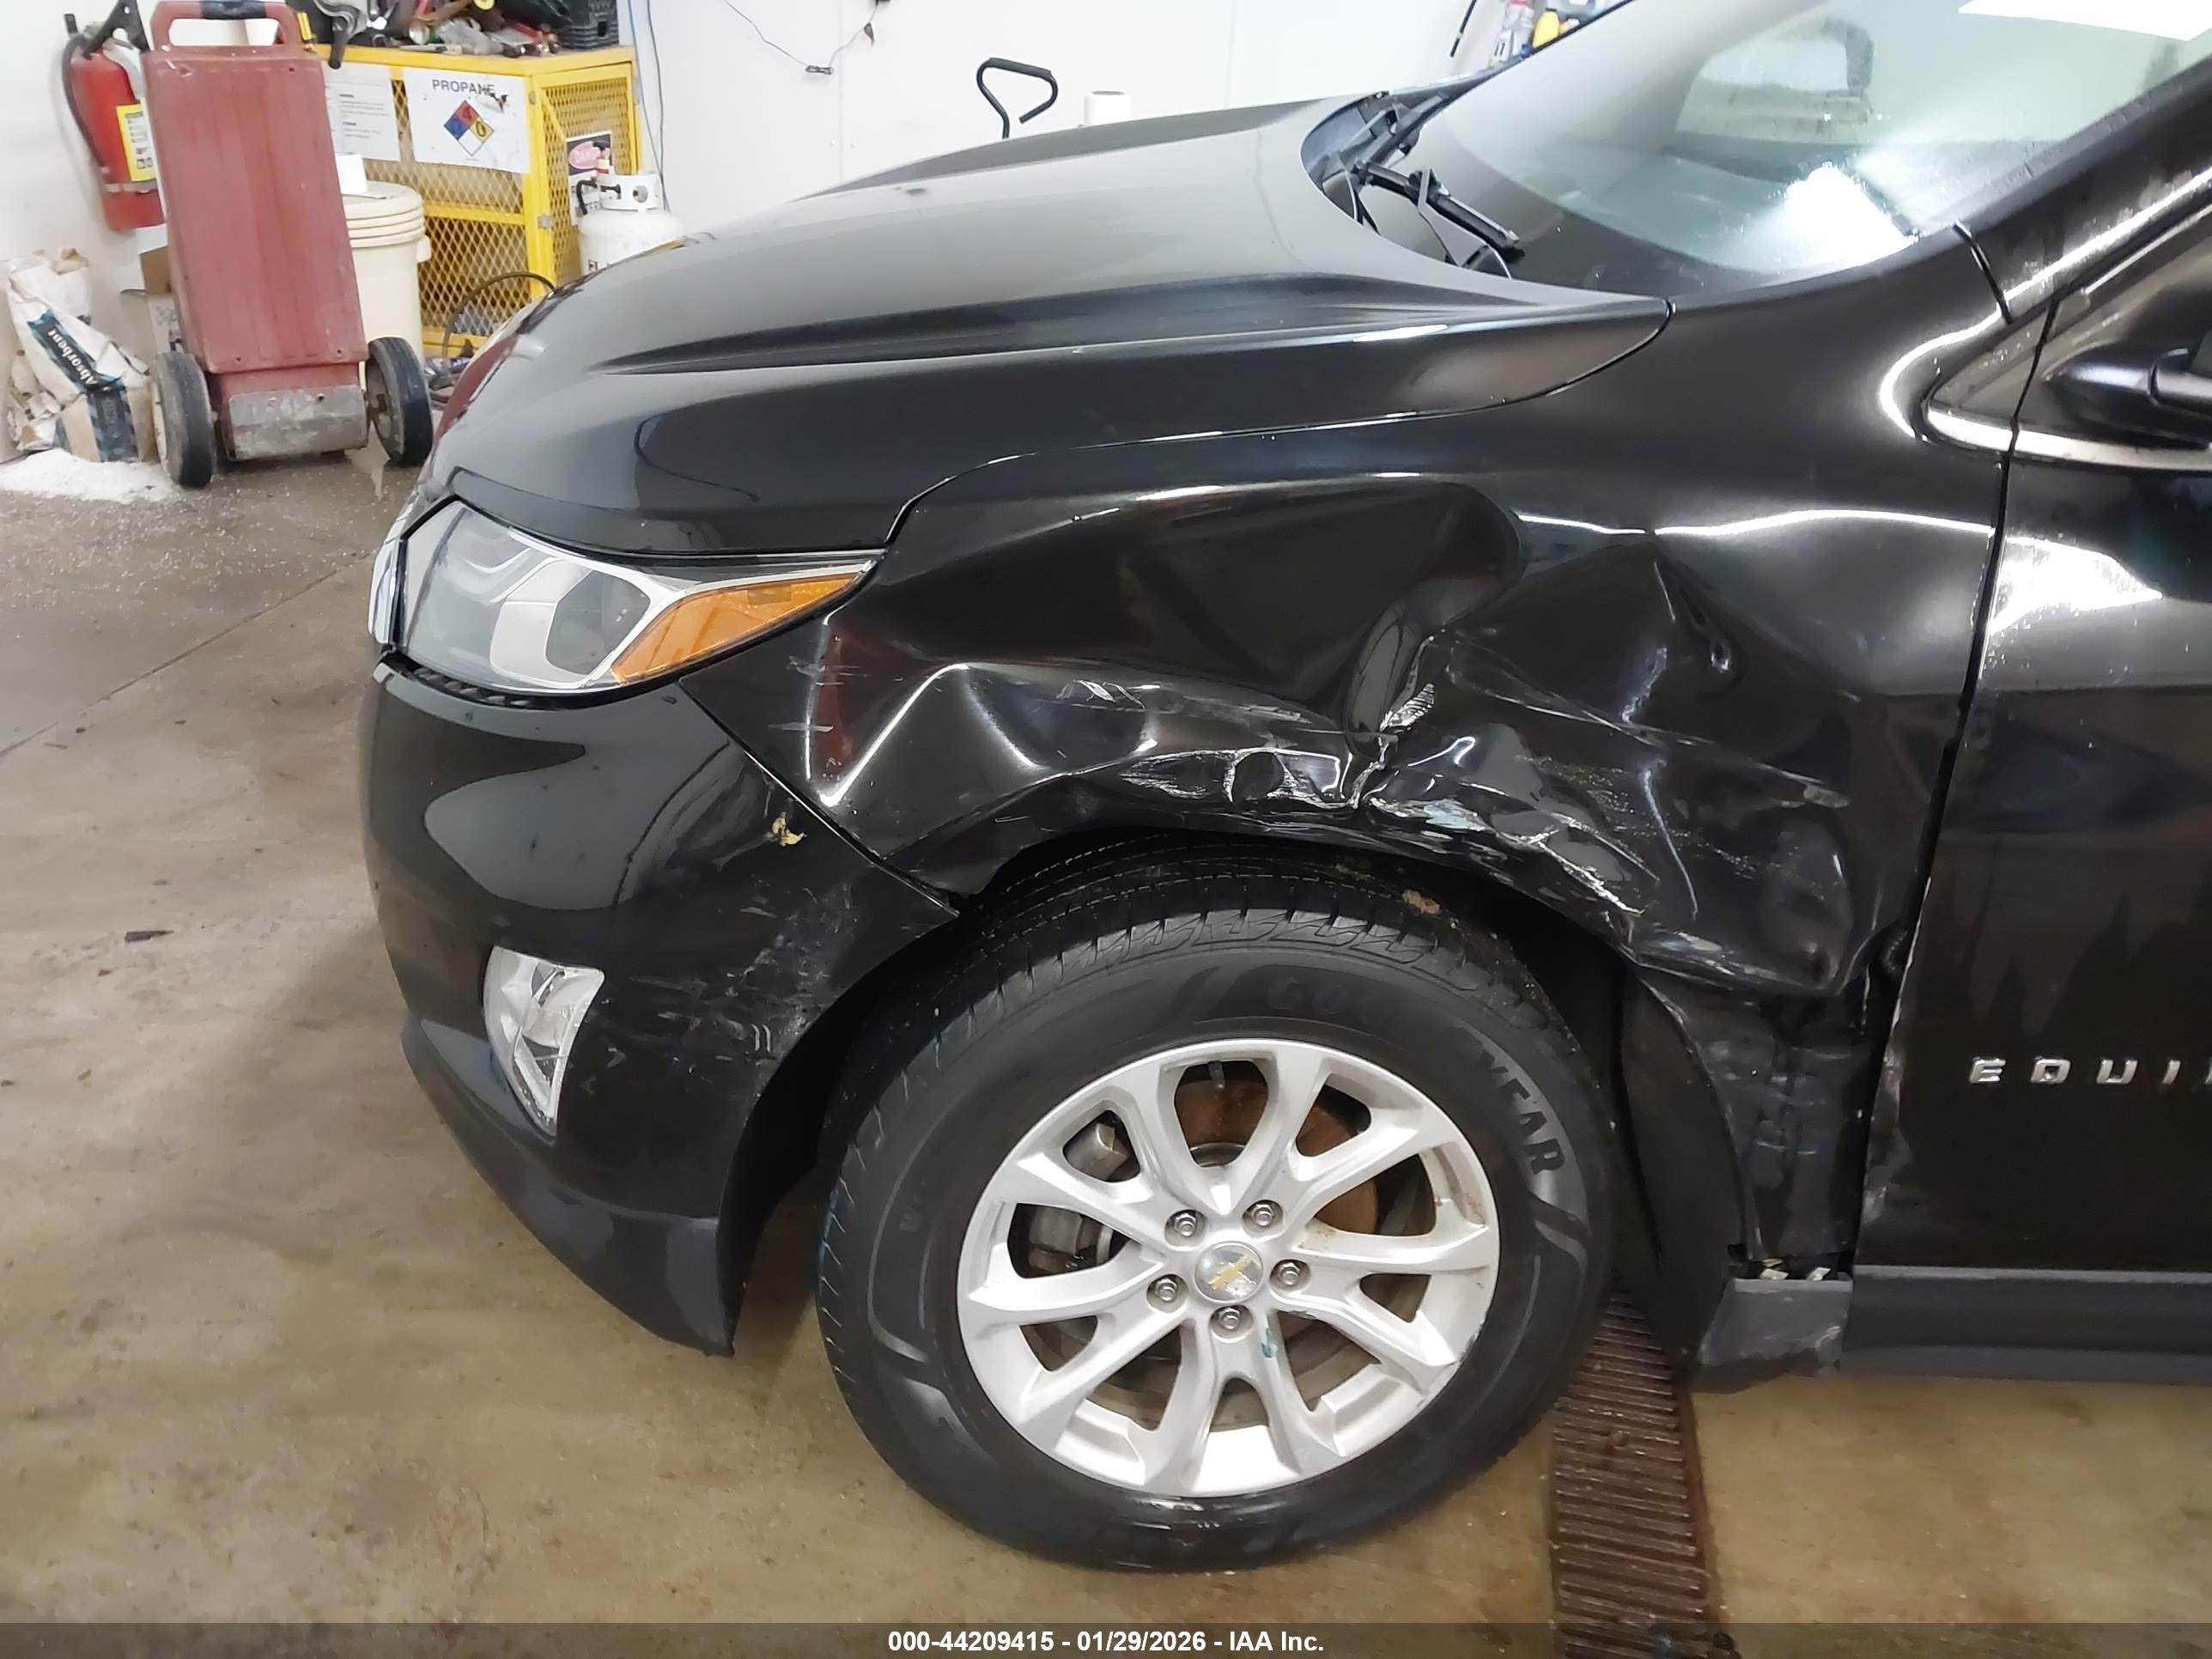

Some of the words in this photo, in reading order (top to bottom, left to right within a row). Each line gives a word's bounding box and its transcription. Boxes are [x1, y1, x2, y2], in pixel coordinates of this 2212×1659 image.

[432, 79, 495, 97] PROPANE
[47, 328, 99, 385] Absorbent
[1968, 1057, 2212, 1085] EQUI
